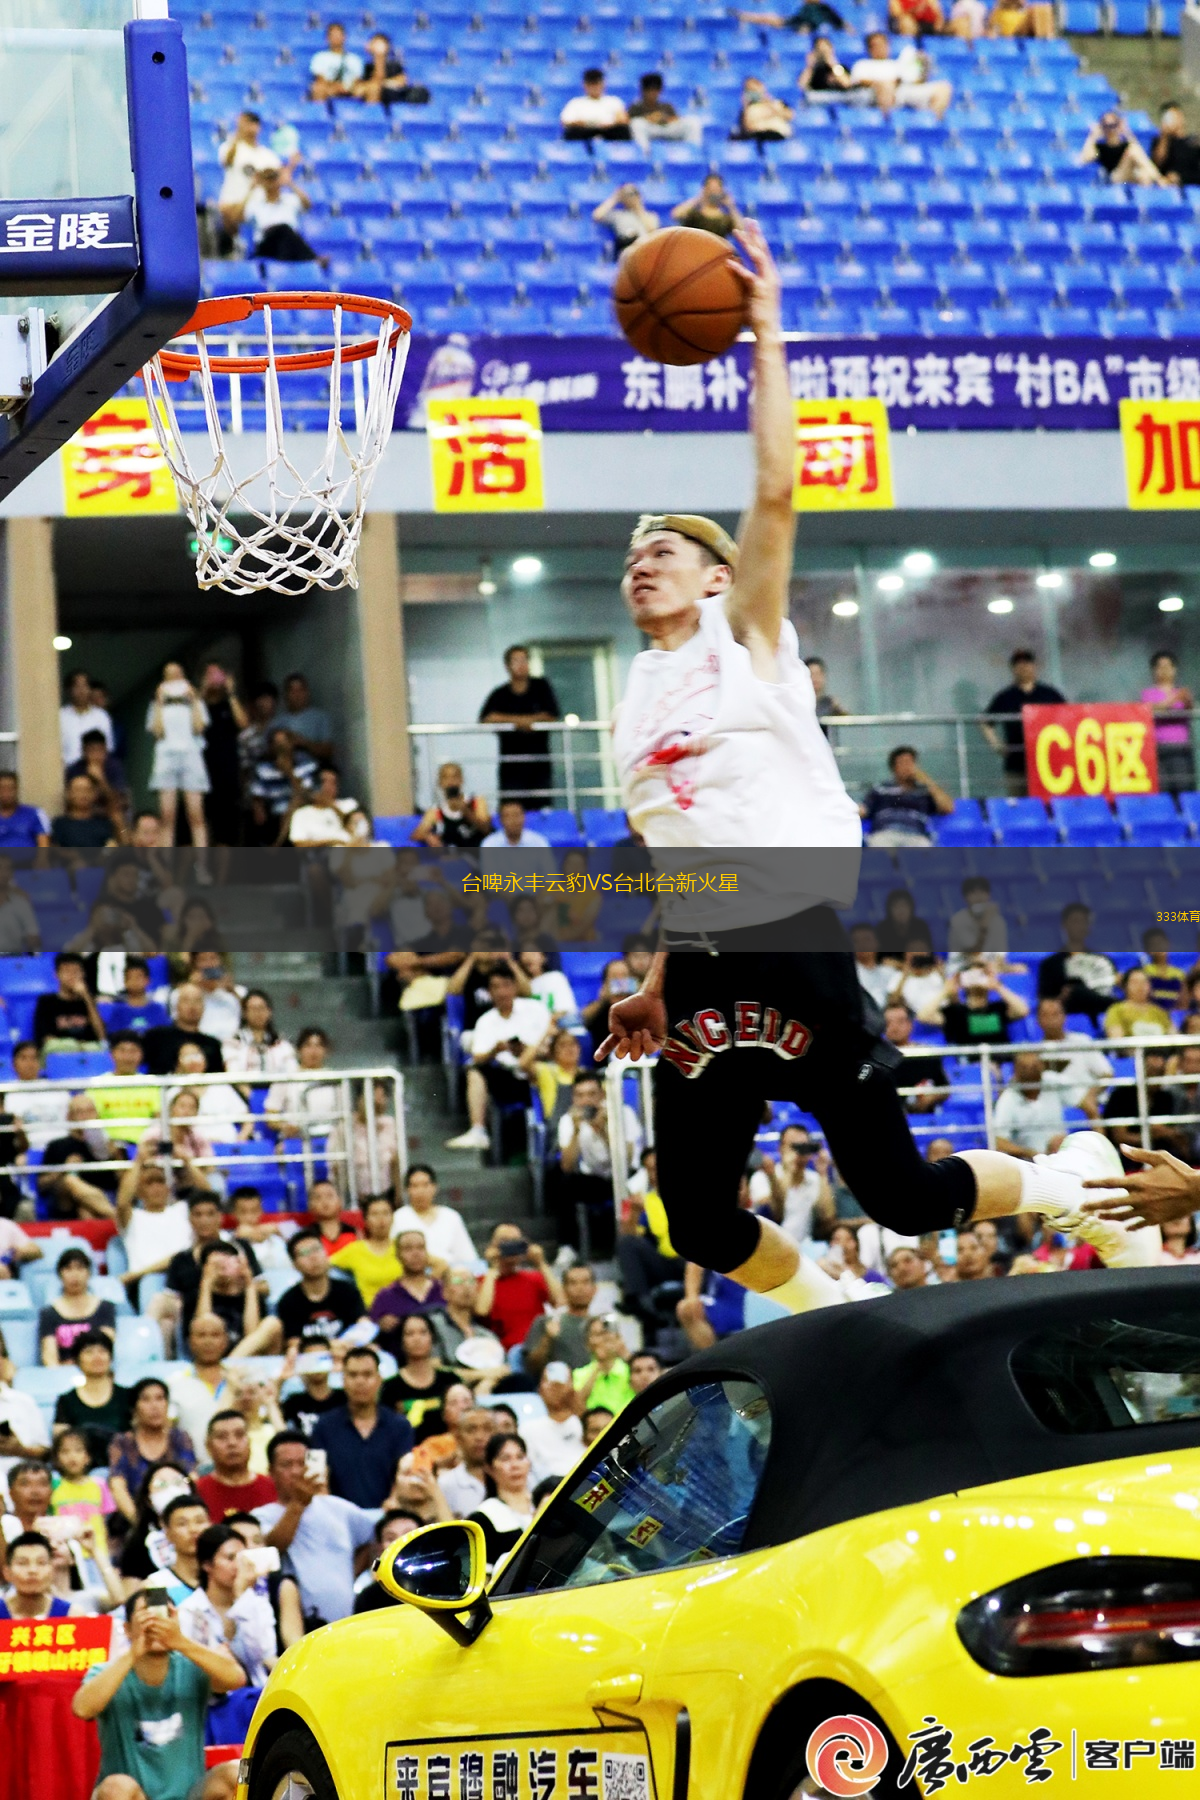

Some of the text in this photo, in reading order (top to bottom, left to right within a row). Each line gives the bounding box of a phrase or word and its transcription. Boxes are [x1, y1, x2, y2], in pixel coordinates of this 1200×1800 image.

[1, 212, 133, 252] 金陵
[620, 354, 1200, 410] 东鹏补啦预祝来宾“村BA”市级
[445, 413, 526, 496] 活
[797, 411, 878, 493] 动
[1134, 413, 1200, 495] 加
[1036, 718, 1152, 796] C6区
